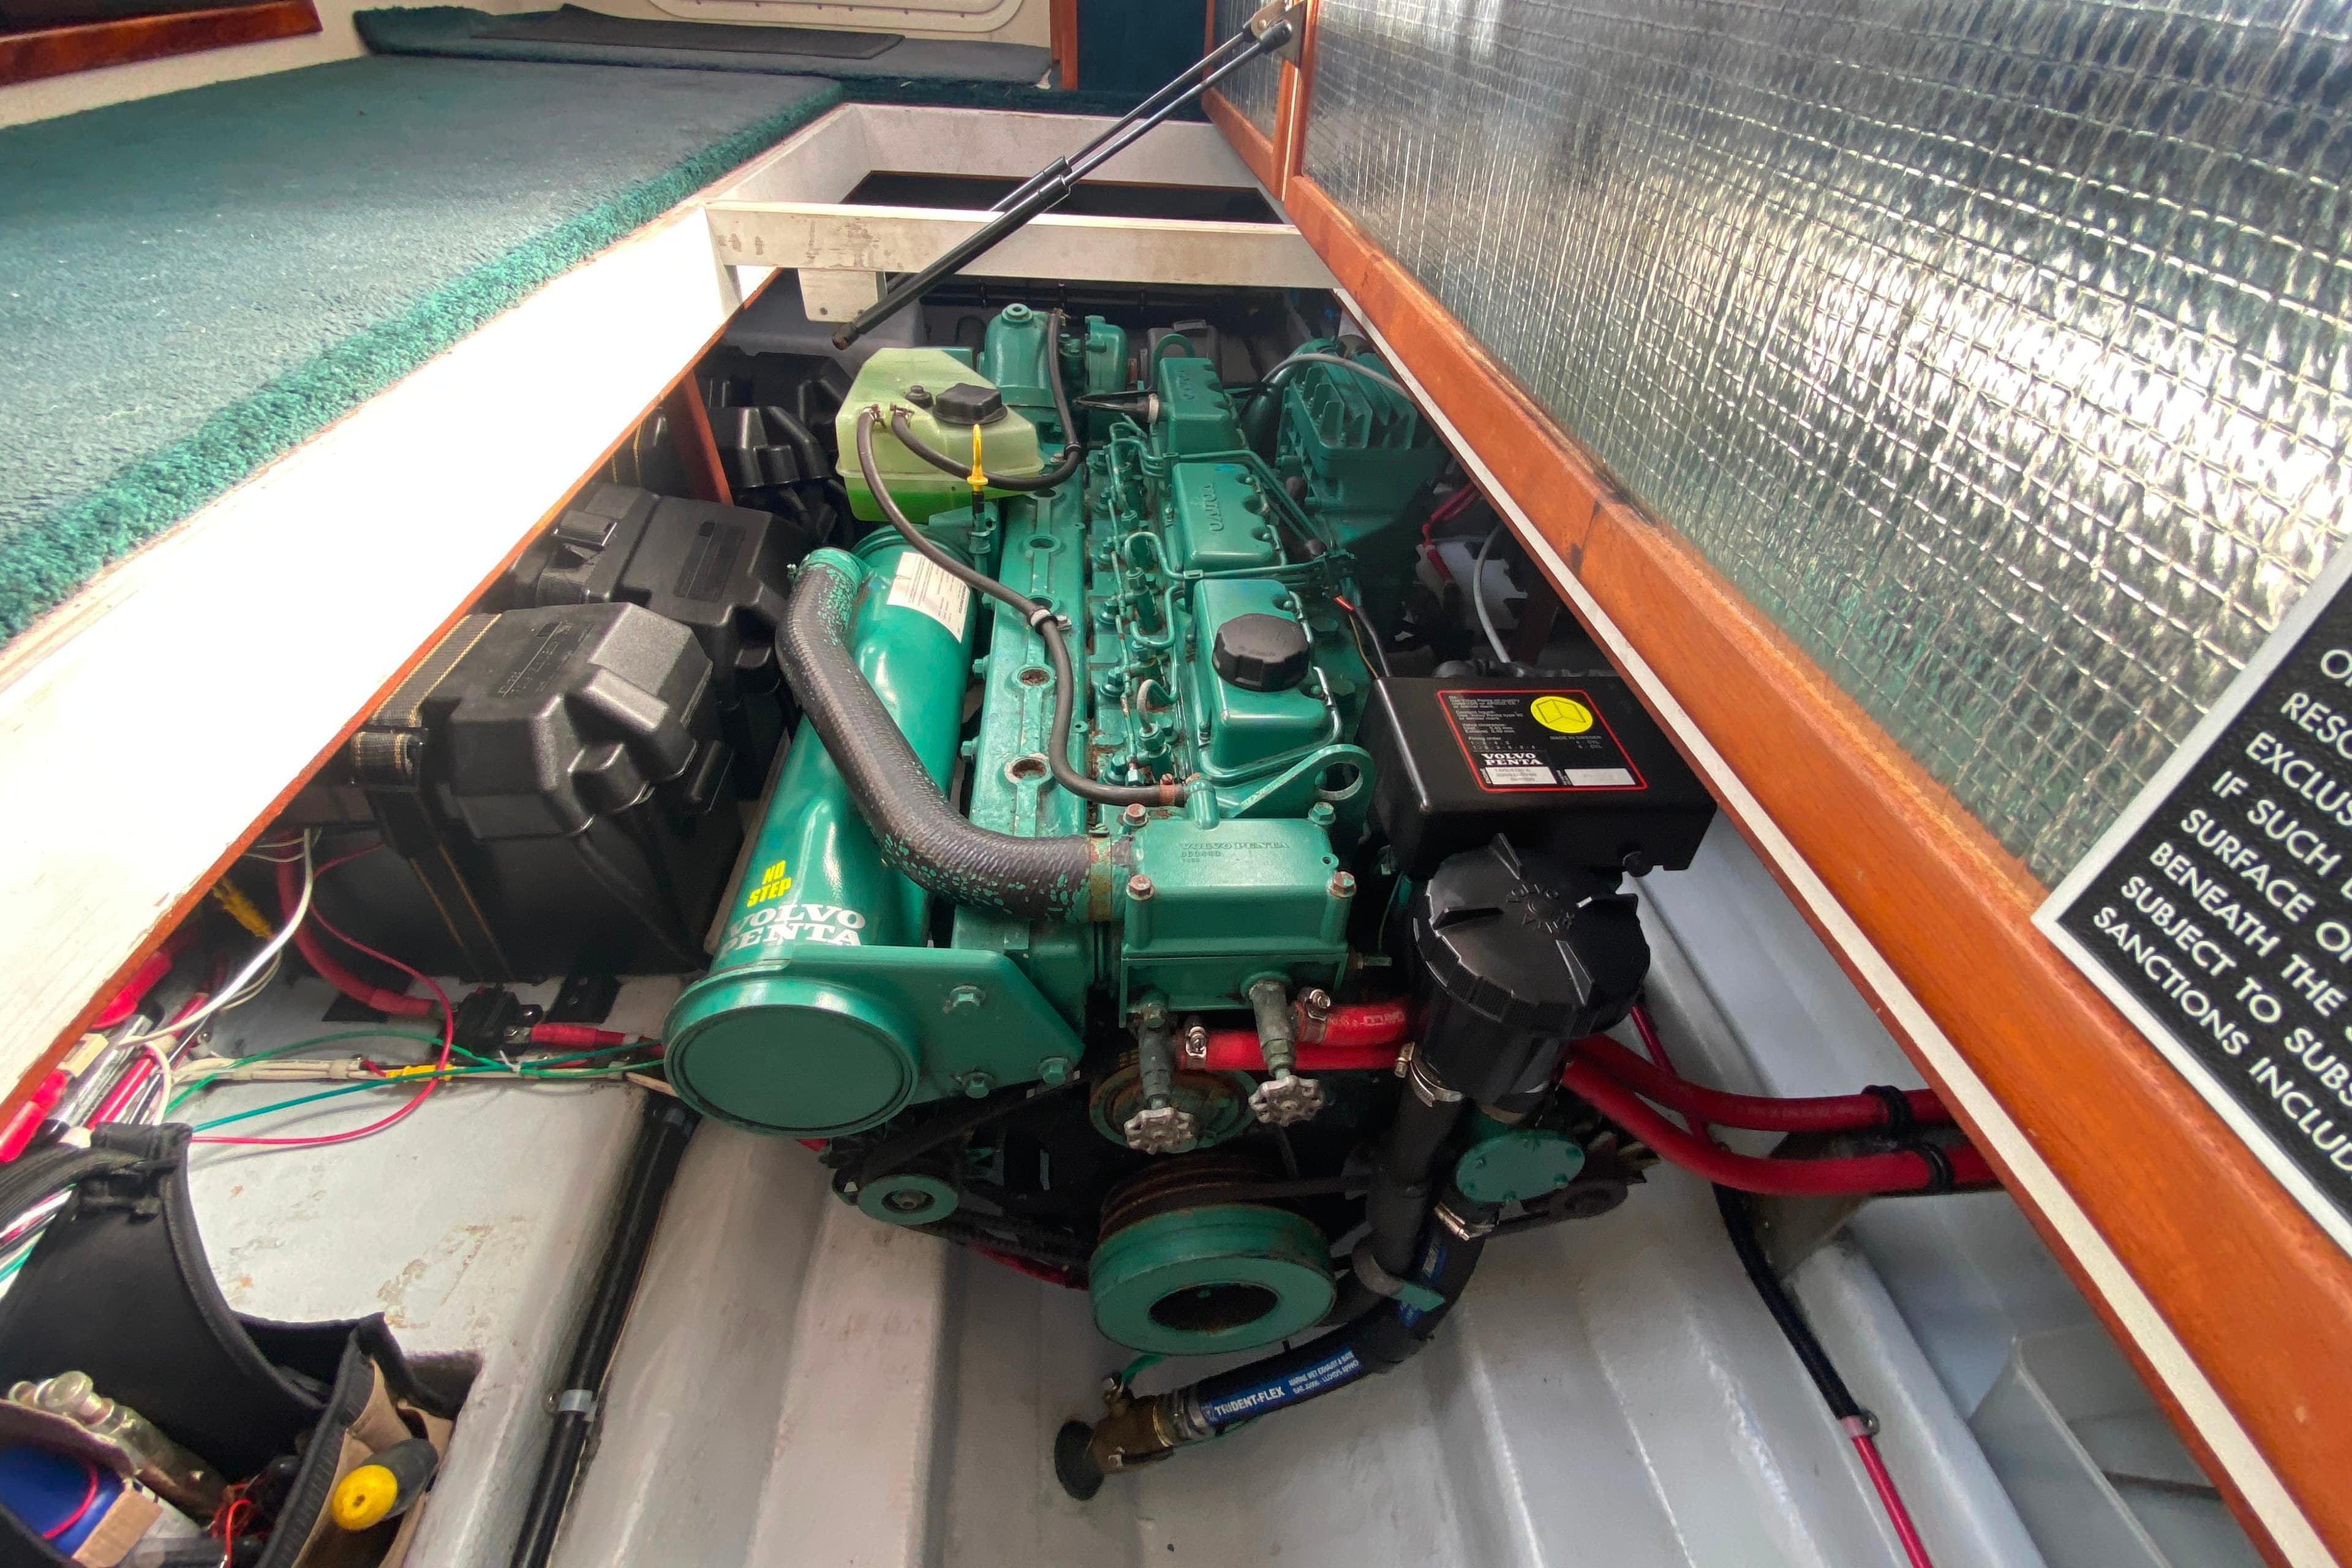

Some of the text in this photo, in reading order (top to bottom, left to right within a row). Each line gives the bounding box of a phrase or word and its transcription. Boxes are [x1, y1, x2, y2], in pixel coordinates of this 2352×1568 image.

[2321, 649, 2352, 687] O
[2212, 771, 2342, 876] IF SUCH
[762, 859, 786, 884] NO
[2181, 809, 2316, 922] SURFACE
[747, 877, 791, 907] STEP
[729, 903, 865, 937] VOLVO
[2149, 842, 2347, 1017] BENEATH THE
[717, 922, 861, 959] PENTA
[2121, 876, 2237, 977] SUBJECT
[2236, 976, 2281, 1022] TO
[2094, 907, 2250, 1055] SANCTIONS
[1214, 1386, 1285, 1416] TRIDENT-FLEX
